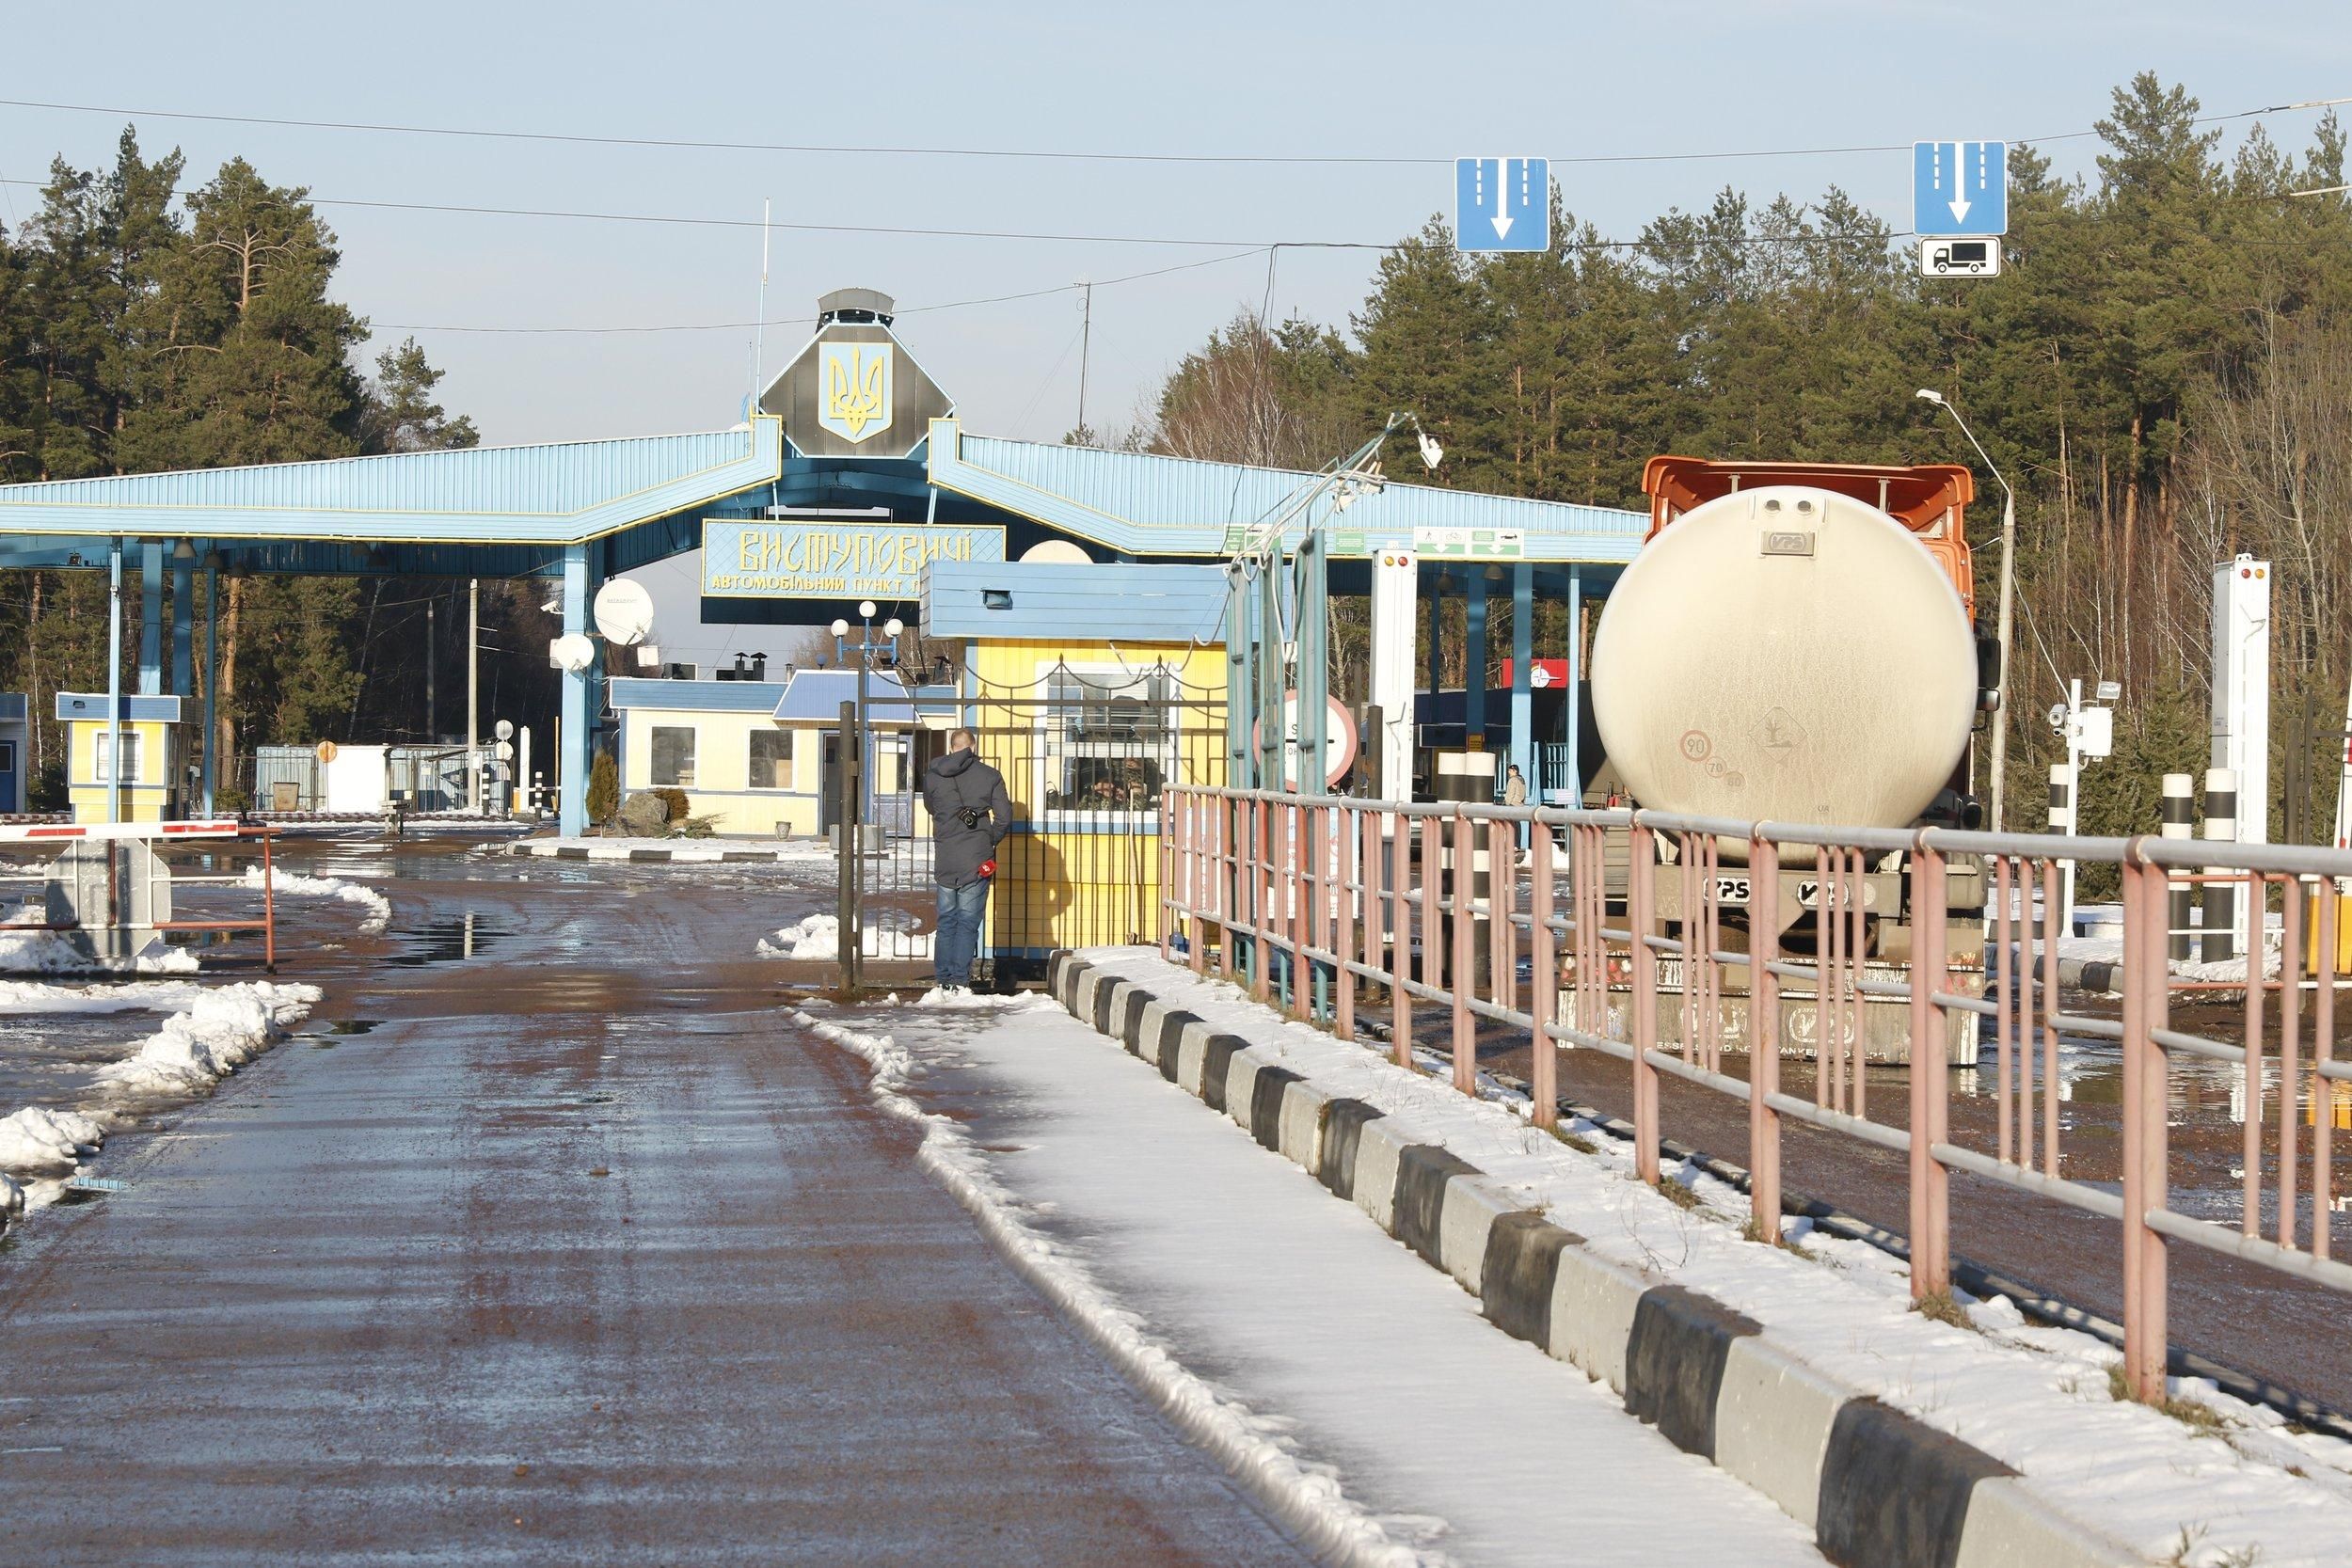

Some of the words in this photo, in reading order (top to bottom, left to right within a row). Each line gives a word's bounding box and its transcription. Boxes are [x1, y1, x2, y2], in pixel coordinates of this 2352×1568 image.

[739, 530, 971, 575] ВИСТУПОВИЧІ
[712, 575, 845, 592] АВТОМОБІЛЬНИЙ
[854, 578, 903, 594] ПУНКТ
[1687, 738, 1704, 752] 90
[1708, 763, 1723, 772] 70
